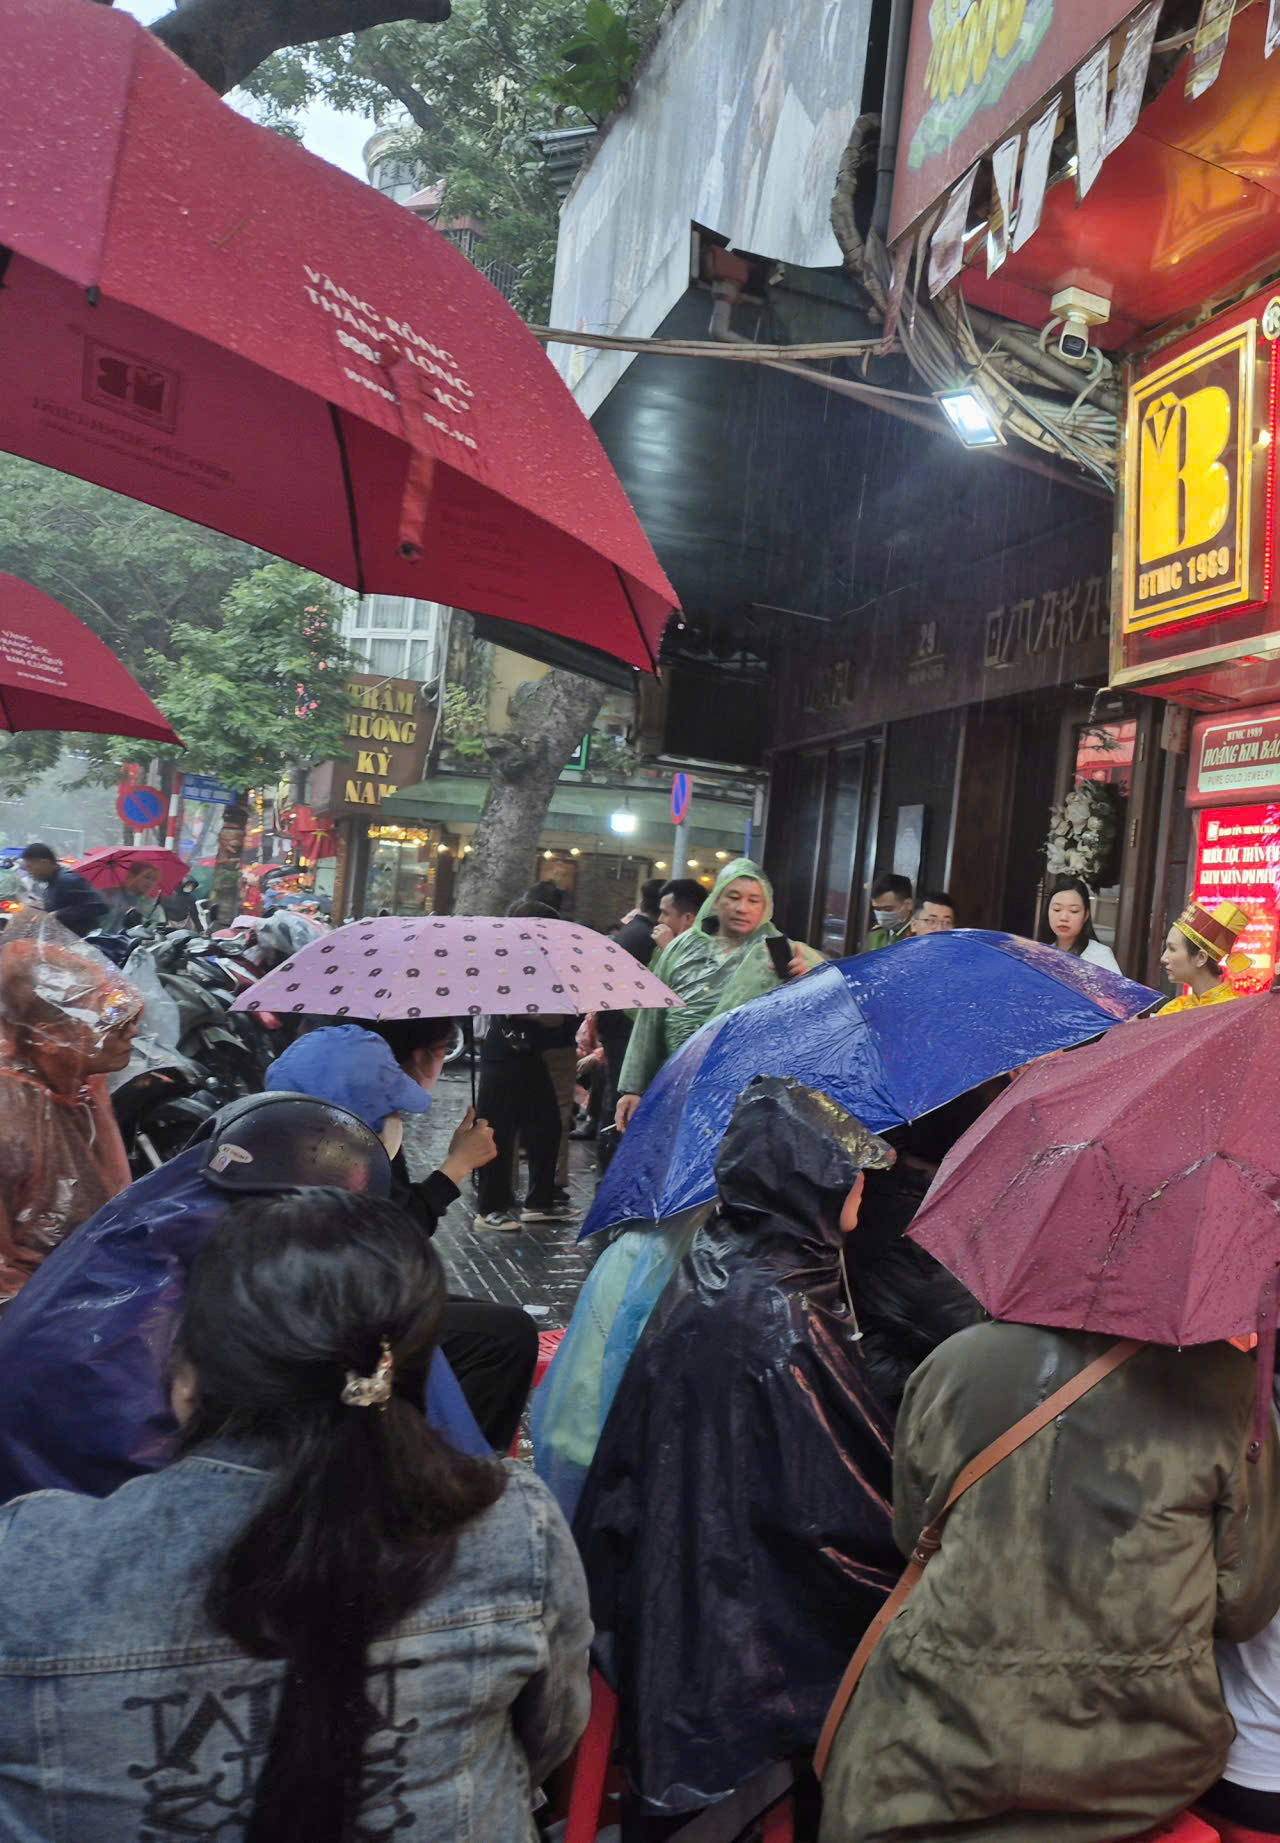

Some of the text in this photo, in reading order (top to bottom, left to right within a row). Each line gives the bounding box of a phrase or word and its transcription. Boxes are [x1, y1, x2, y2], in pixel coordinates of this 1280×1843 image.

[304, 265, 381, 321] VÀNG
[405, 347, 474, 397] LONG
[1139, 546, 1230, 600] BTMC 1989
[356, 747, 392, 776] KỲ
